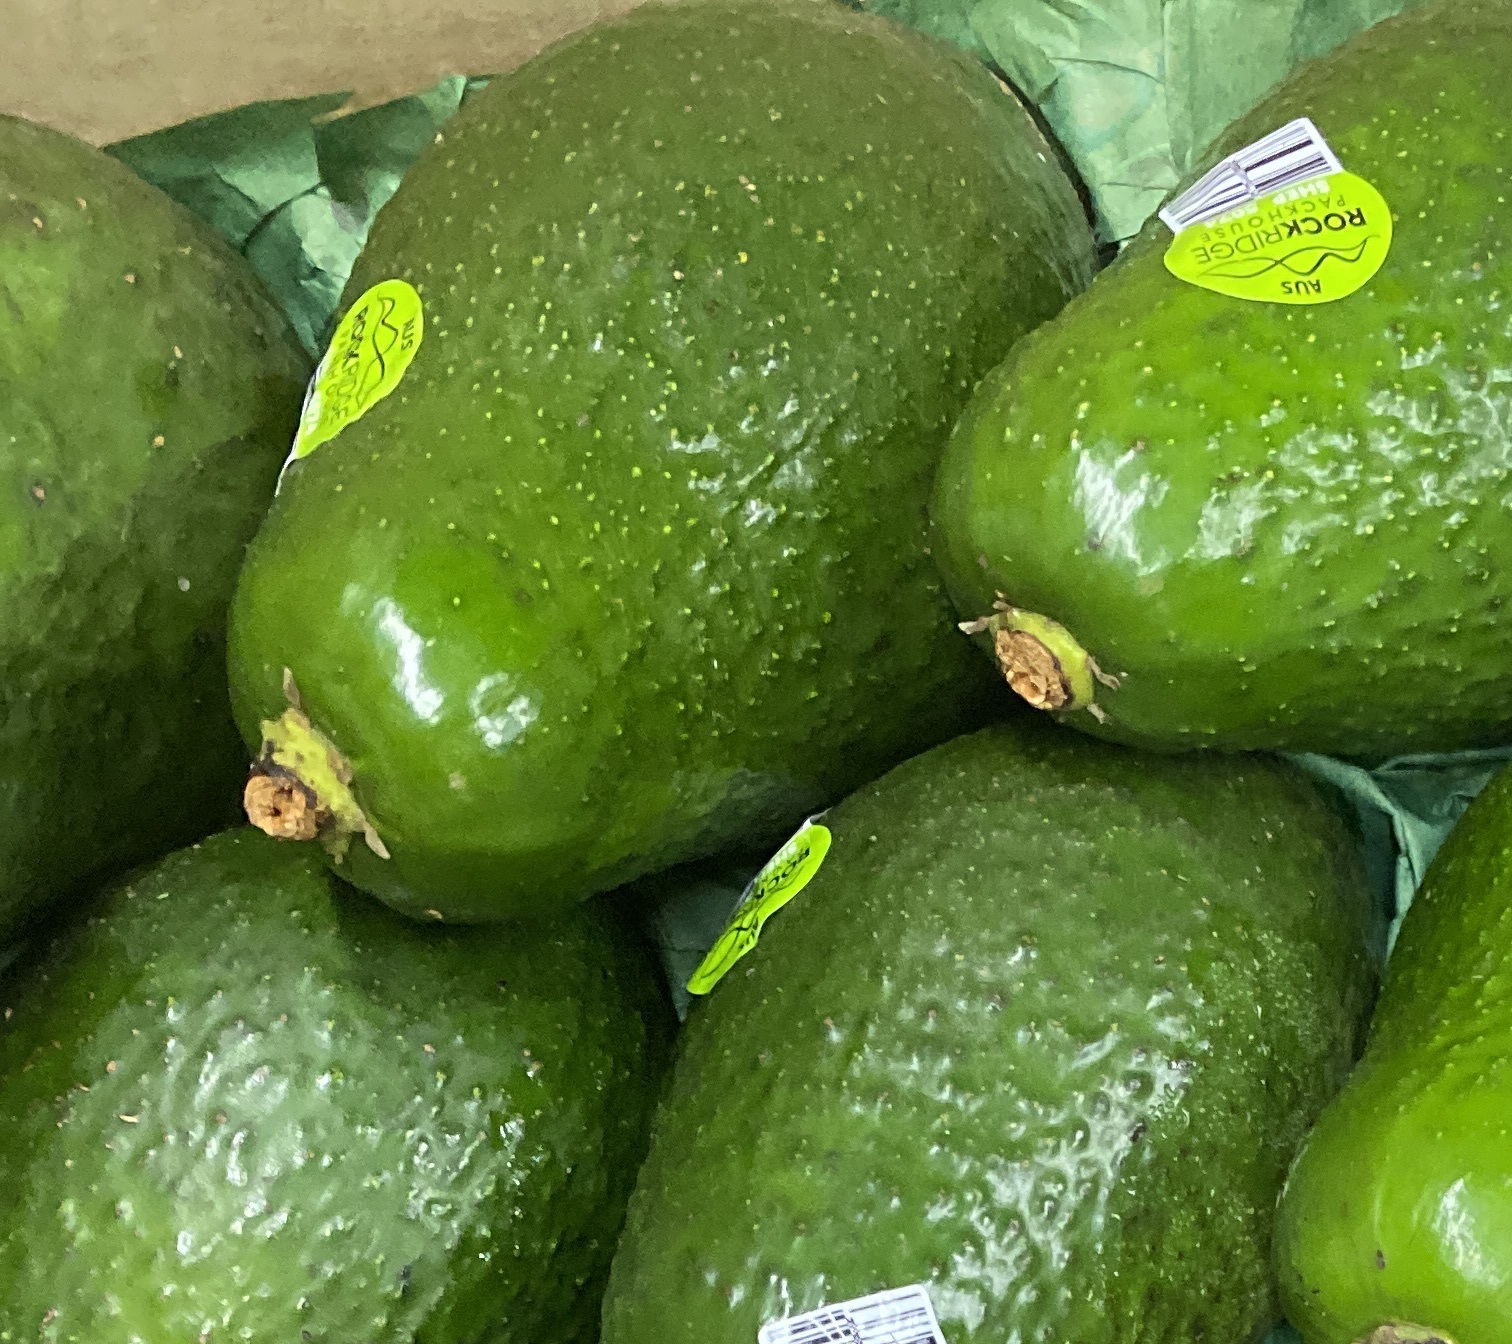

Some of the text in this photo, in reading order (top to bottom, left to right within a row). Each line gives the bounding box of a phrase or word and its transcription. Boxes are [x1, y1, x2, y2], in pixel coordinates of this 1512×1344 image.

[1272, 180, 1331, 205] SHEP
[1191, 207, 1367, 265] ROCKRIDGE
[1199, 194, 1346, 243] PACKHOUSE
[1281, 279, 1321, 294] AUS
